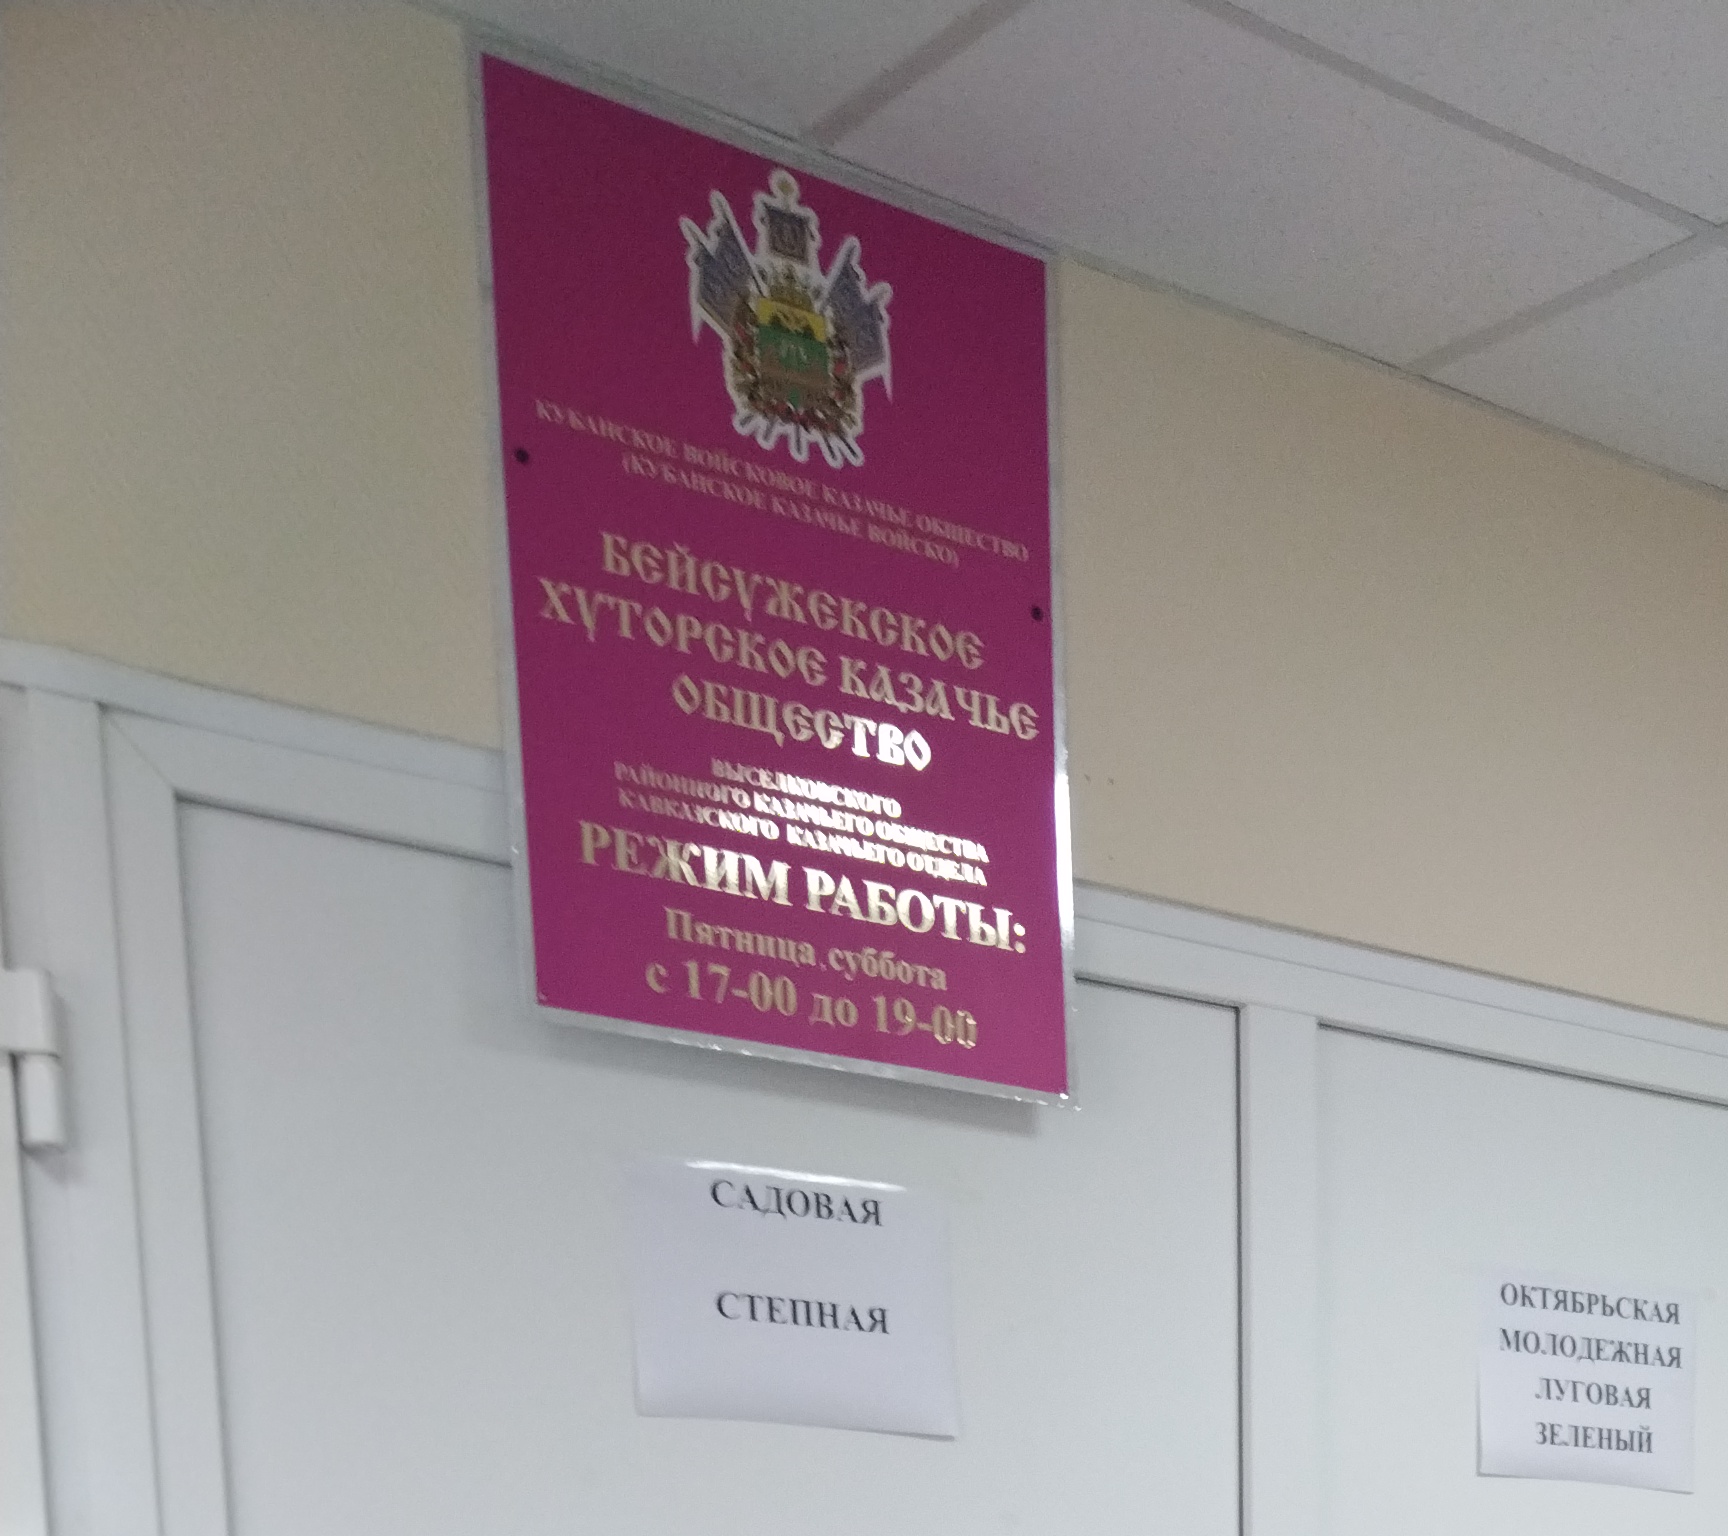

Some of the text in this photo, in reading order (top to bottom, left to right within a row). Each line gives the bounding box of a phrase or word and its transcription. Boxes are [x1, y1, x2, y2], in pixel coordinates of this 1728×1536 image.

[601, 530, 986, 671] БЕЙСУЖЕКСКОЕ
[536, 575, 1040, 742] ХУТОРСКОЕ КАЗАЧЬЕ
[671, 672, 932, 772] ОБЩЕСТВО
[578, 820, 1026, 954] РЕЖИМ РАБОТЫ:
[828, 946, 947, 991] суббота
[683, 959, 798, 1017] 17-00
[809, 992, 859, 1029] до
[873, 995, 978, 1050] 19-00
[710, 1179, 884, 1227] САДОВАЯ
[715, 1291, 890, 1335] СТЕПНАЯ
[1500, 1282, 1681, 1325] ОКТЯБРЬСКАЯ
[1500, 1328, 1683, 1369] МОЛОДЕЖНАЯ
[1535, 1377, 1652, 1410] ЛУГОВАЯ
[1535, 1421, 1653, 1454] ЗЕЛЕНЫЙ
